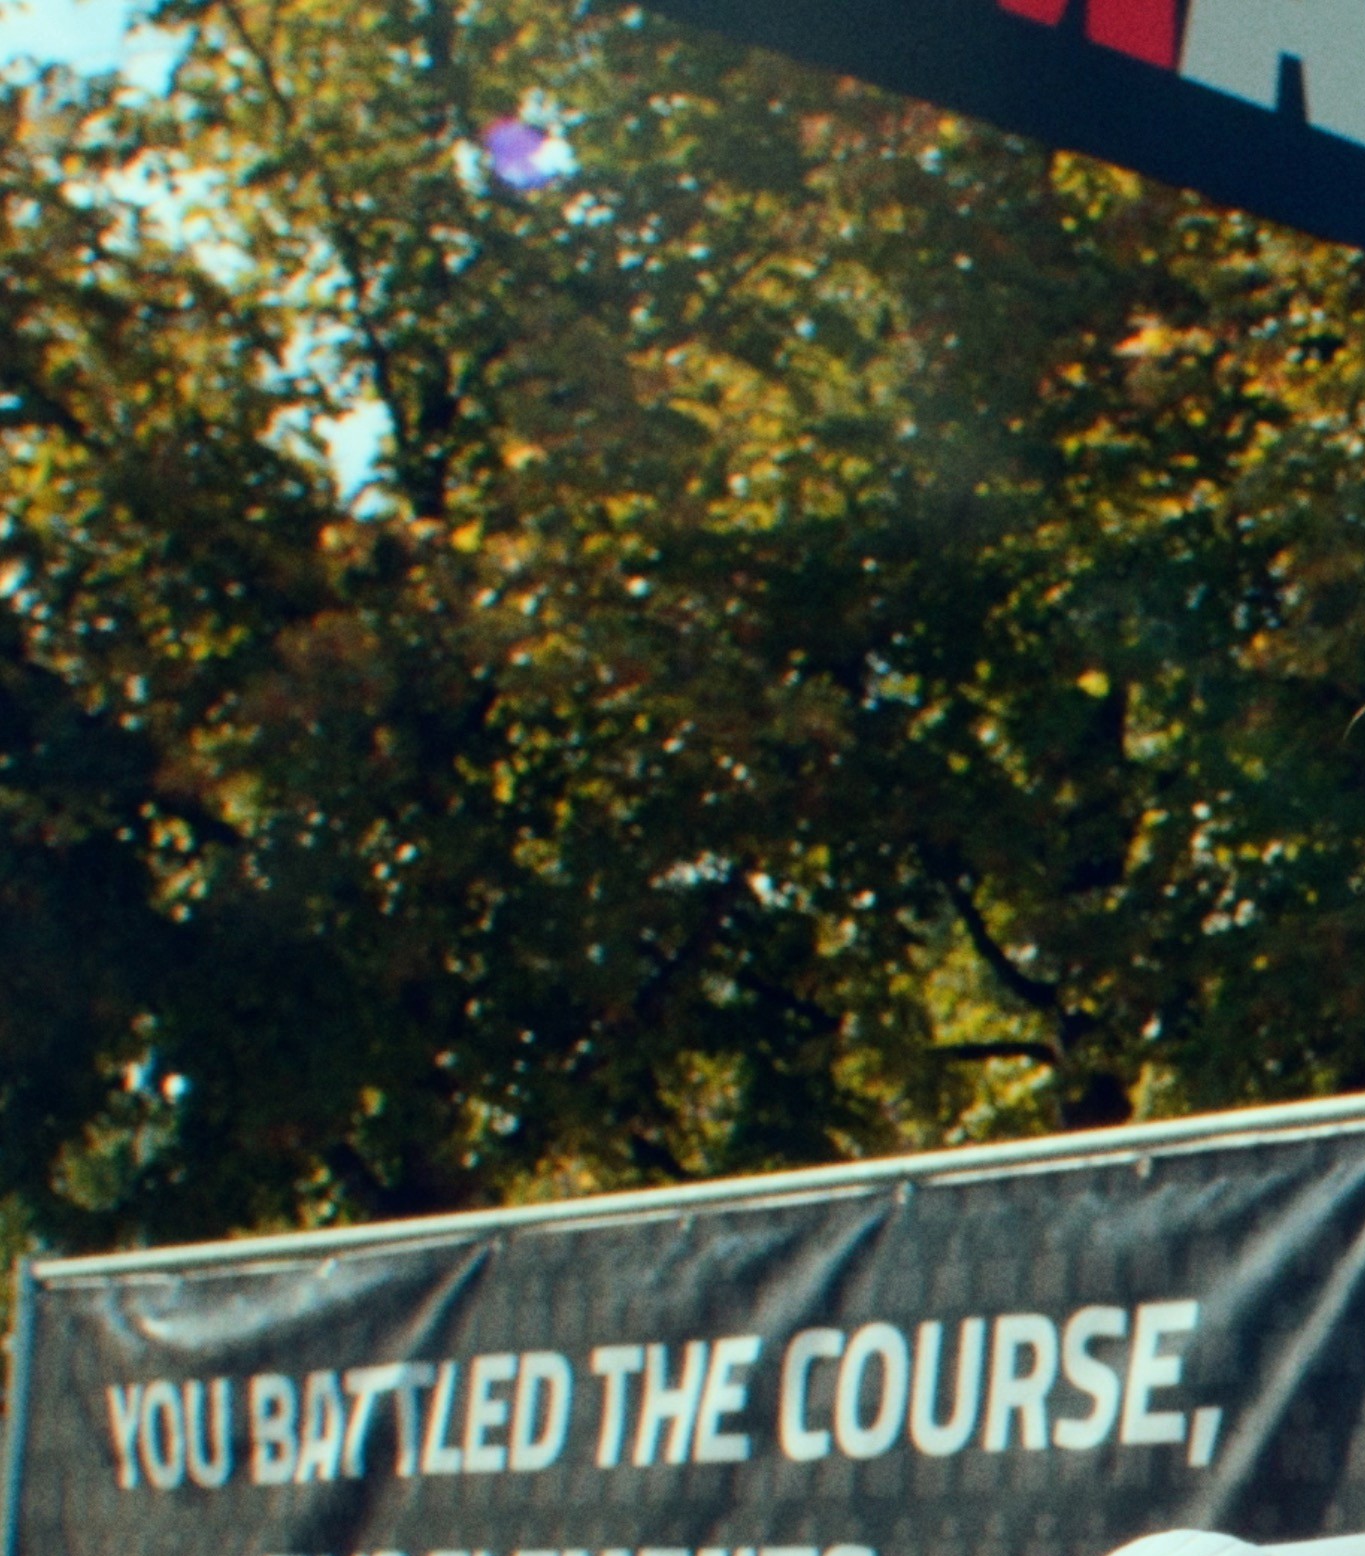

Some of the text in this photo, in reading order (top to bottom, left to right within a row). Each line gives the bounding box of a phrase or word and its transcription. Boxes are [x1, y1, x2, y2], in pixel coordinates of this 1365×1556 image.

[108, 1300, 1222, 1491] YOU BATTLED THE COURSE,
